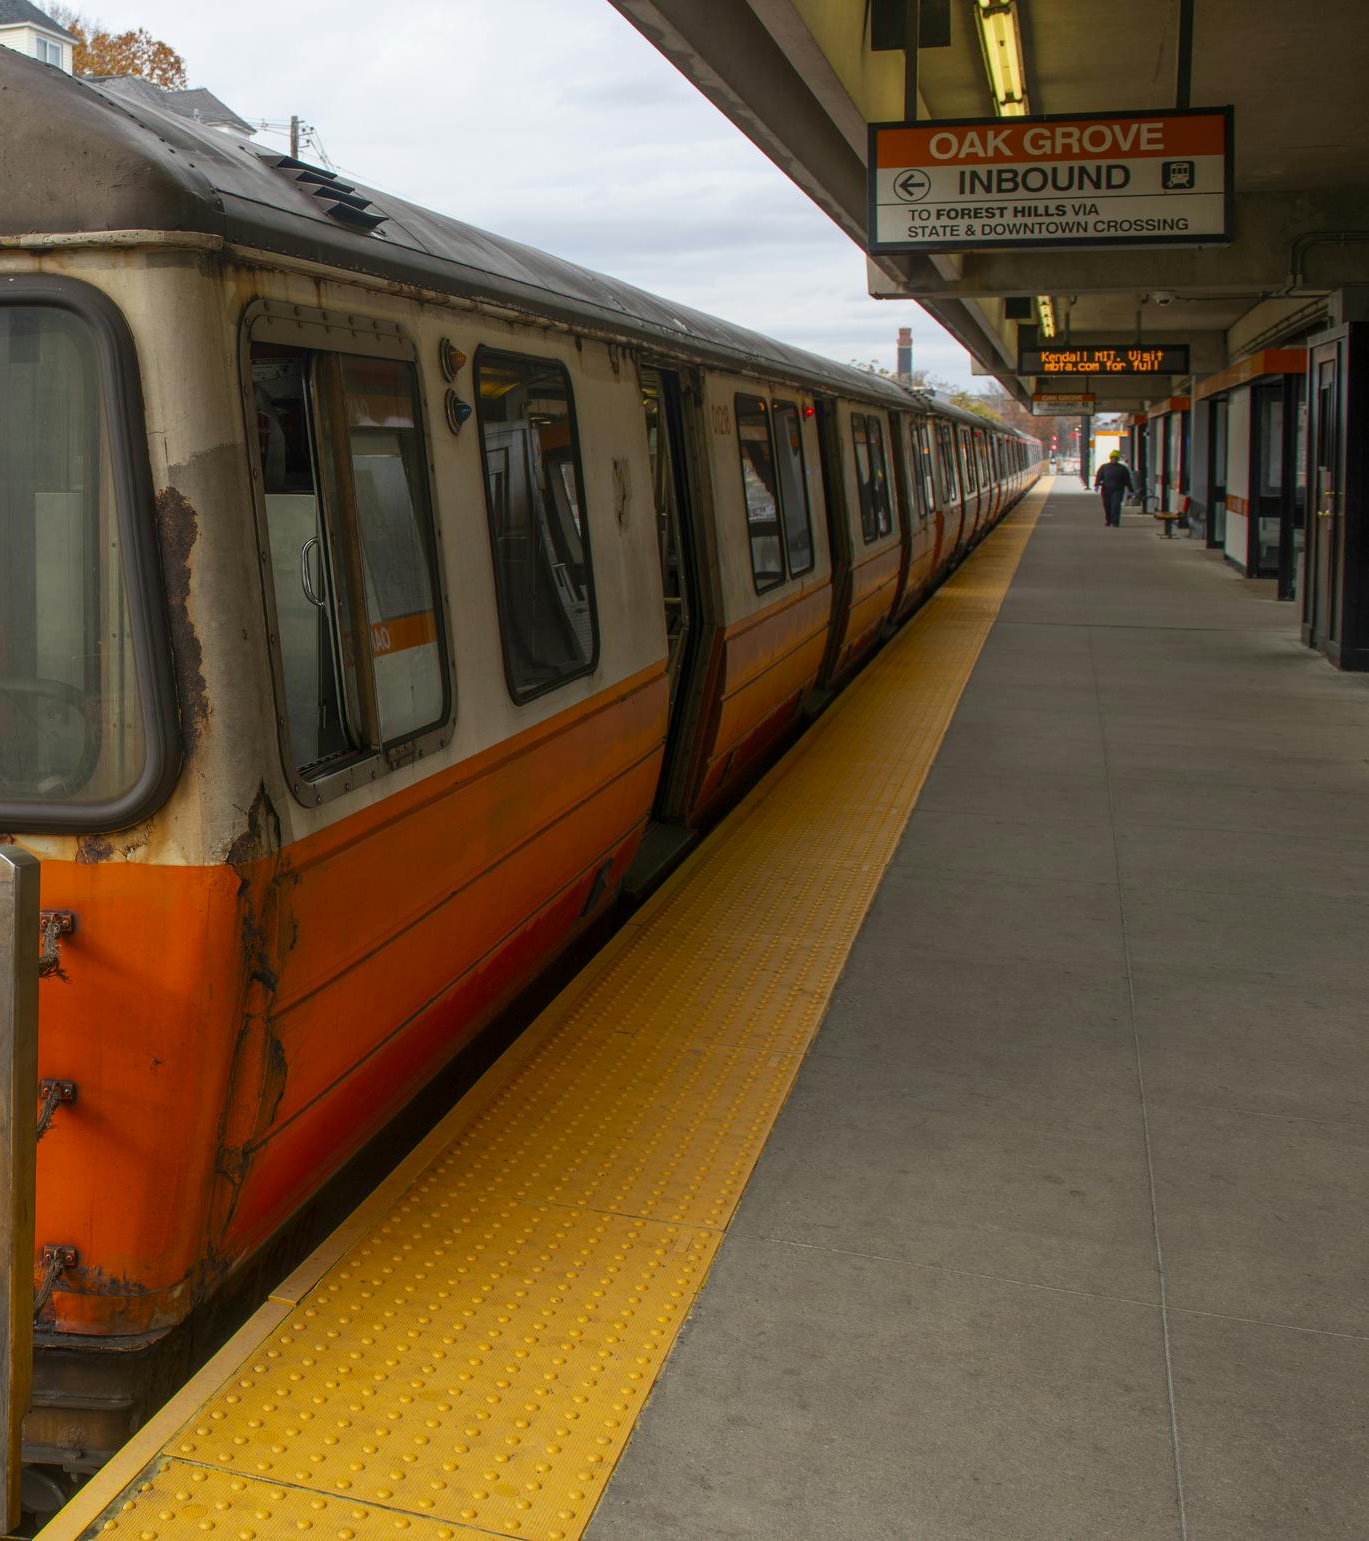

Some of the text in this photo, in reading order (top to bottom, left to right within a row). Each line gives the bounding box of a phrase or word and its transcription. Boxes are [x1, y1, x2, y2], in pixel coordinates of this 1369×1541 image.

[929, 122, 1165, 159] OAK GROVE
[959, 164, 1131, 195] INBOUND
[908, 203, 1099, 221] TO FOREST HILLS VIA
[907, 218, 1189, 238] STATE & DOWNTOWN CROSSING
[1040, 351, 1087, 363] Kendall
[1128, 350, 1164, 362] Visit
[1044, 360, 1159, 372] mbta.com for full
